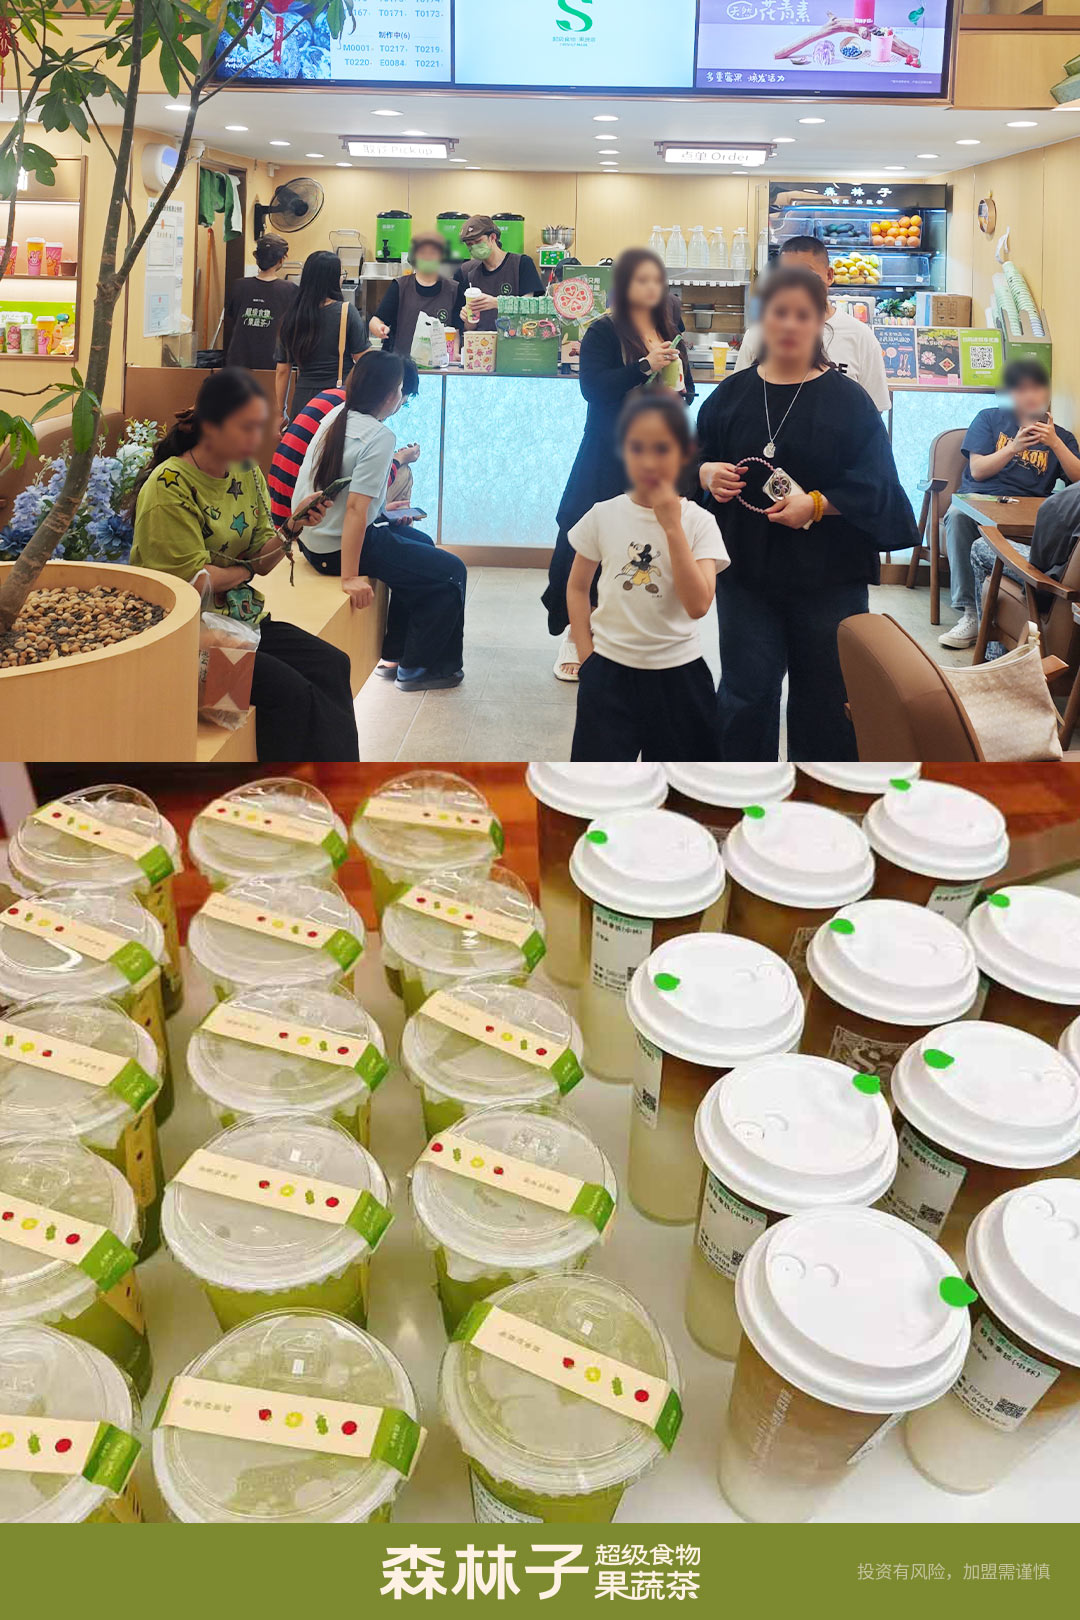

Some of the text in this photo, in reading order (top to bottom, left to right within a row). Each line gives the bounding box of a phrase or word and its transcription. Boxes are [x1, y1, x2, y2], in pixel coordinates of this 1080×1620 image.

[345, 9, 441, 18] 167 T0171 T0173
[343, 44, 370, 52] M0001
[345, 58, 370, 66] T0220
[415, 60, 440, 68] T0221
[391, 145, 433, 156] Pickup
[711, 151, 750, 161] Order
[823, 186, 893, 198] 森林子
